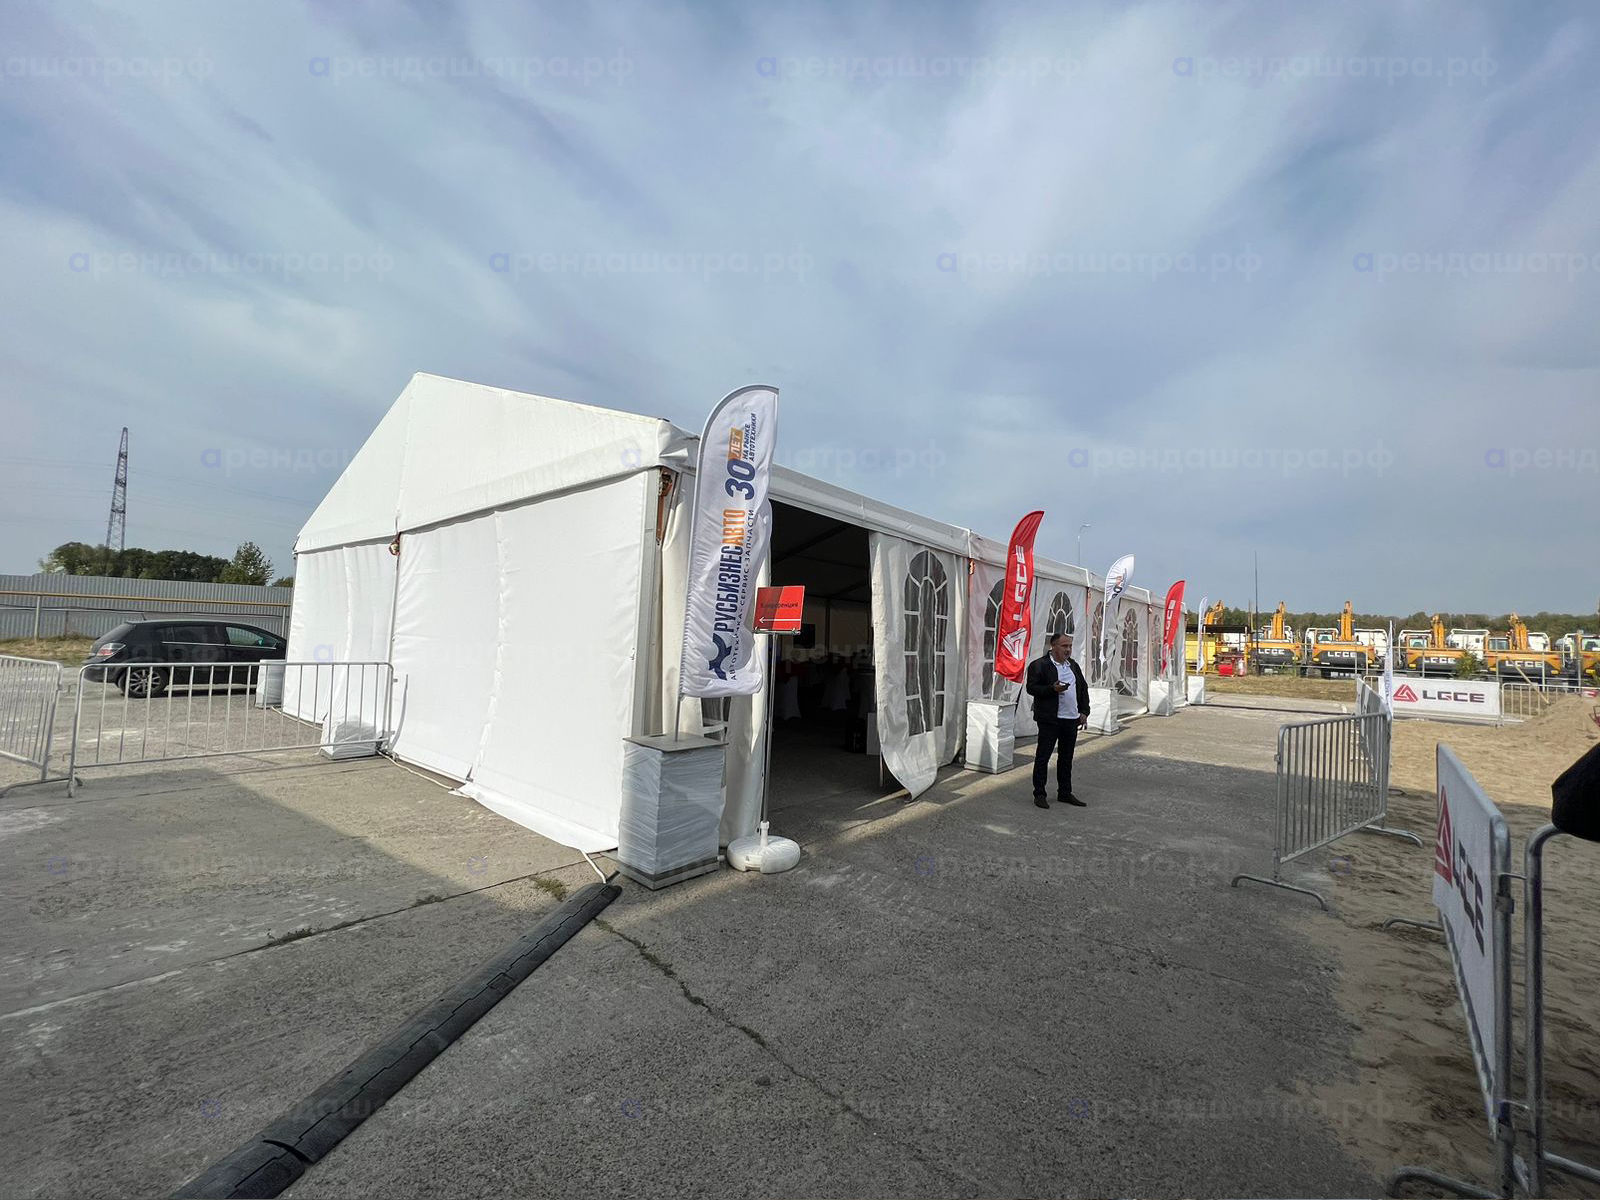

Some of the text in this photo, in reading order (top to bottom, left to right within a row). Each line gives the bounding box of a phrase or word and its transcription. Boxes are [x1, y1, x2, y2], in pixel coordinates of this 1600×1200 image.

[725, 431, 756, 500] 30 ЛЕТ
[713, 509, 746, 633] РУСБИЗНЕСАВТО
[1012, 545, 1028, 621] LGCE
[1422, 690, 1485, 703] LGCE
